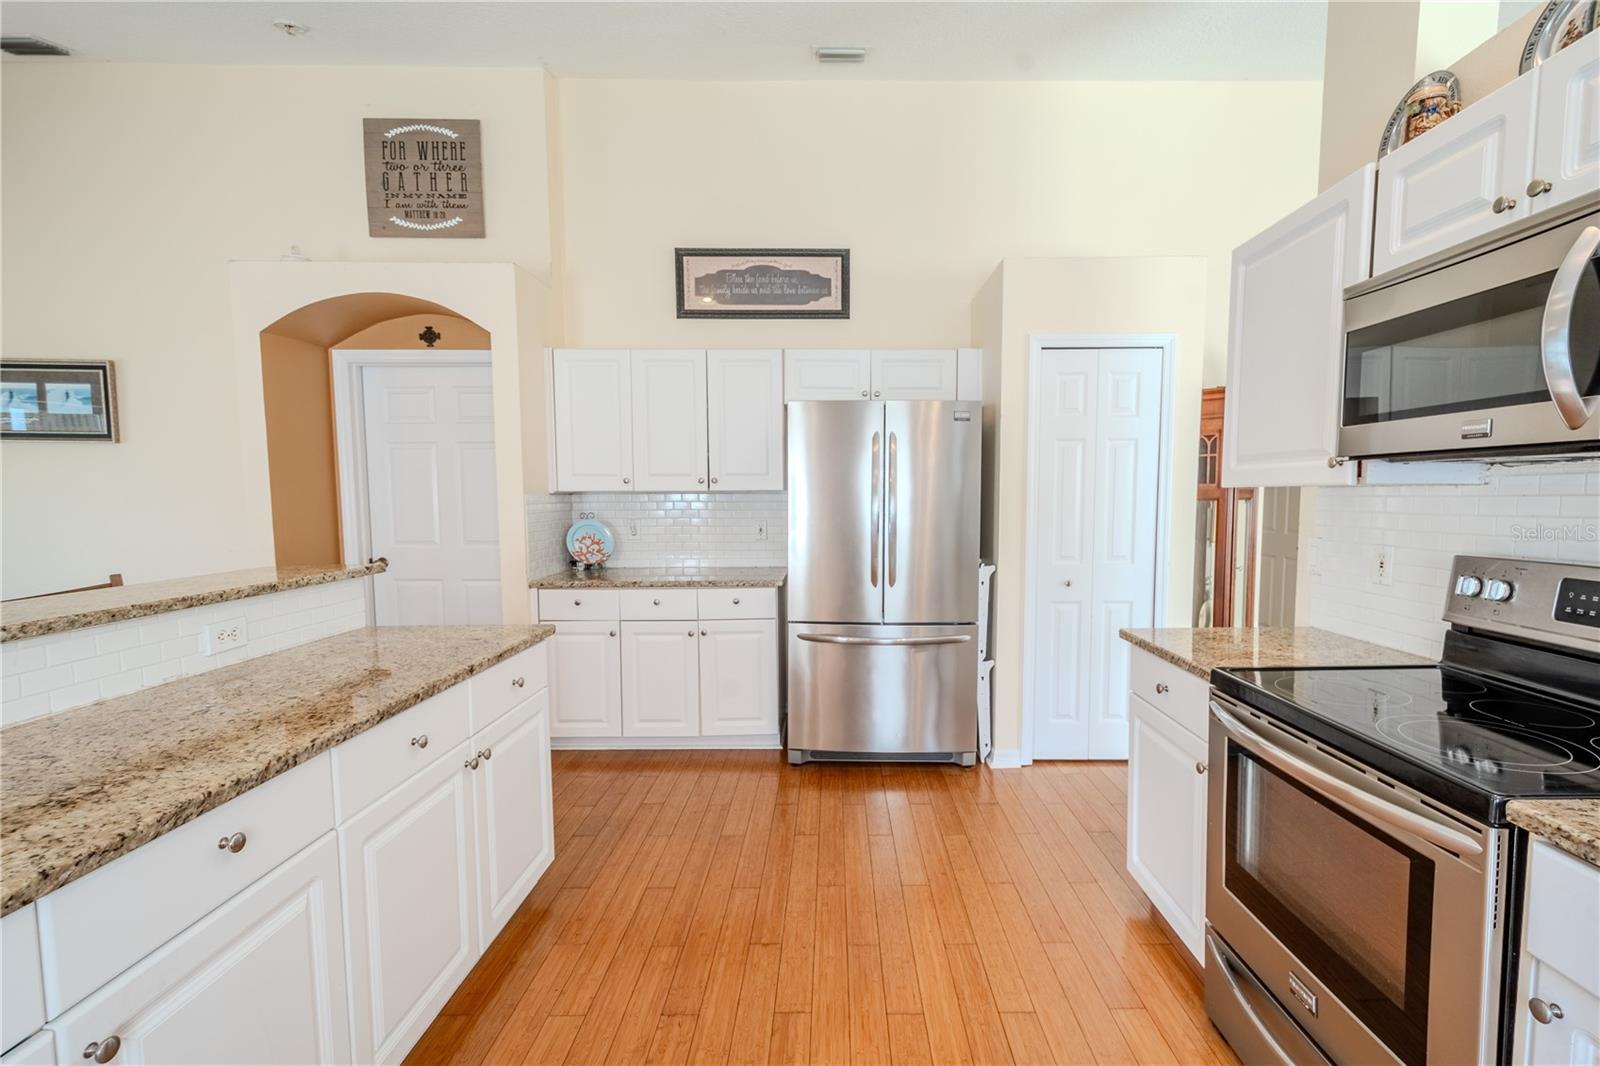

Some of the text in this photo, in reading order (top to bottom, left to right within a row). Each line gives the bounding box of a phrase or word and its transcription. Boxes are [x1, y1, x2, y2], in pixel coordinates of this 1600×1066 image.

[1525, 2, 1558, 63] THE GREAT
[382, 141, 466, 161] FOR WHERE
[382, 160, 466, 172] two or three
[382, 172, 468, 192] GATHER
[384, 199, 391, 209] I
[416, 199, 439, 209] with
[440, 199, 469, 209] them
